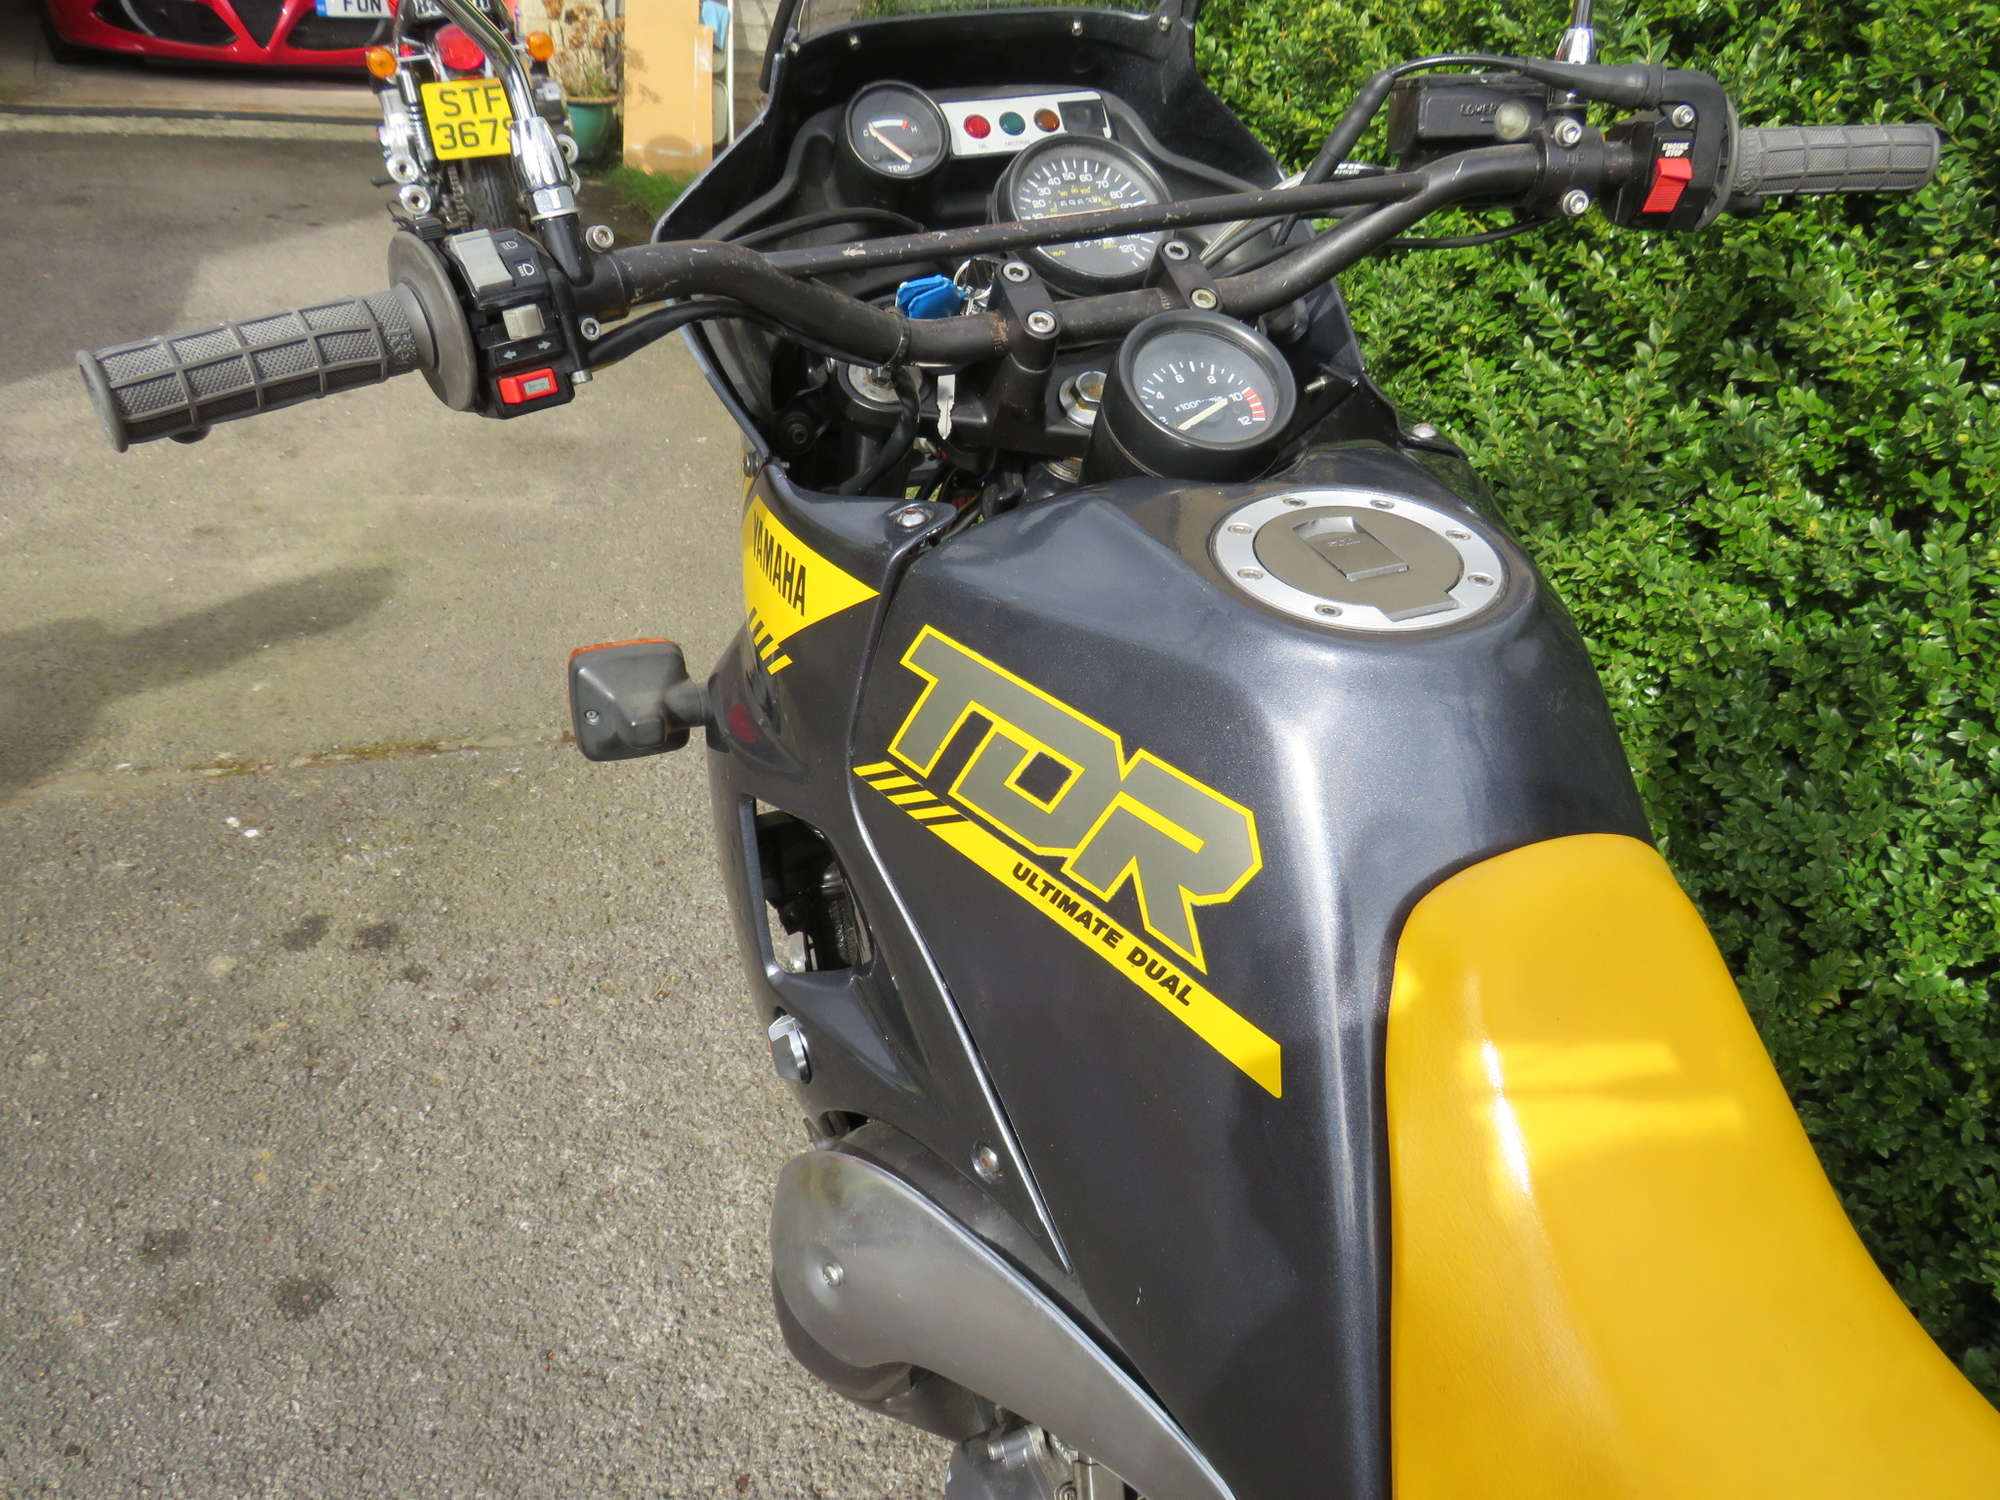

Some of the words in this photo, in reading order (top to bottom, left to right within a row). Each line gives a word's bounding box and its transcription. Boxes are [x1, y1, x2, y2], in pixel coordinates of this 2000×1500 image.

[439, 86, 501, 117] STF
[1661, 142, 1689, 151] ENGINE
[1665, 150, 1685, 158] STOP
[888, 163, 910, 173] TEMP
[1047, 177, 1062, 186] 40
[1062, 172, 1076, 181] 50
[1079, 174, 1093, 183] 60
[1095, 180, 1110, 189] 70
[1037, 187, 1051, 196] 30
[1110, 190, 1124, 199] 80
[1032, 199, 1046, 209] 20
[1119, 244, 1137, 254] 120
[1175, 374, 1185, 384] 6
[1206, 375, 1217, 385] 8
[1155, 391, 1165, 401] 4
[1229, 391, 1244, 402] 10
[1238, 415, 1253, 426] 12
[752, 511, 808, 617] YAMAHA
[887, 624, 1264, 976] TDR
[1011, 861, 1122, 950] ULTIMATE
[1125, 945, 1195, 1007] DUAL
